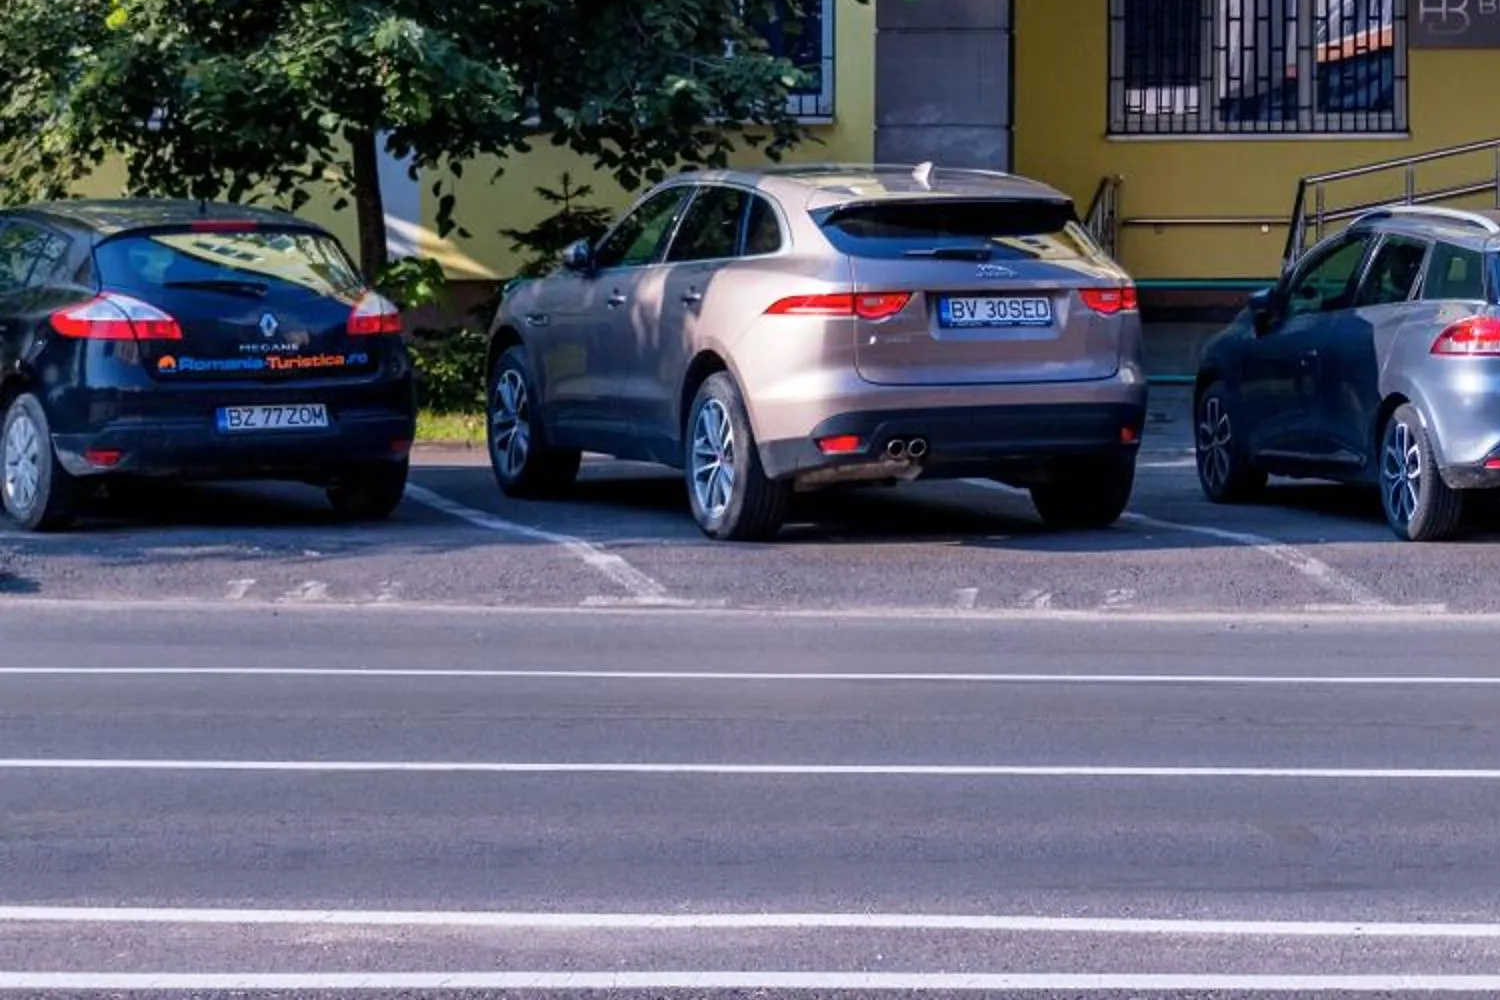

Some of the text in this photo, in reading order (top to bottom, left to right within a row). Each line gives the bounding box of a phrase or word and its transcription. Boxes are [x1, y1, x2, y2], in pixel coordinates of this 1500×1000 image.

[951, 300, 977, 319] BV
[239, 343, 300, 351] MEGANE
[228, 408, 257, 427] BZ
